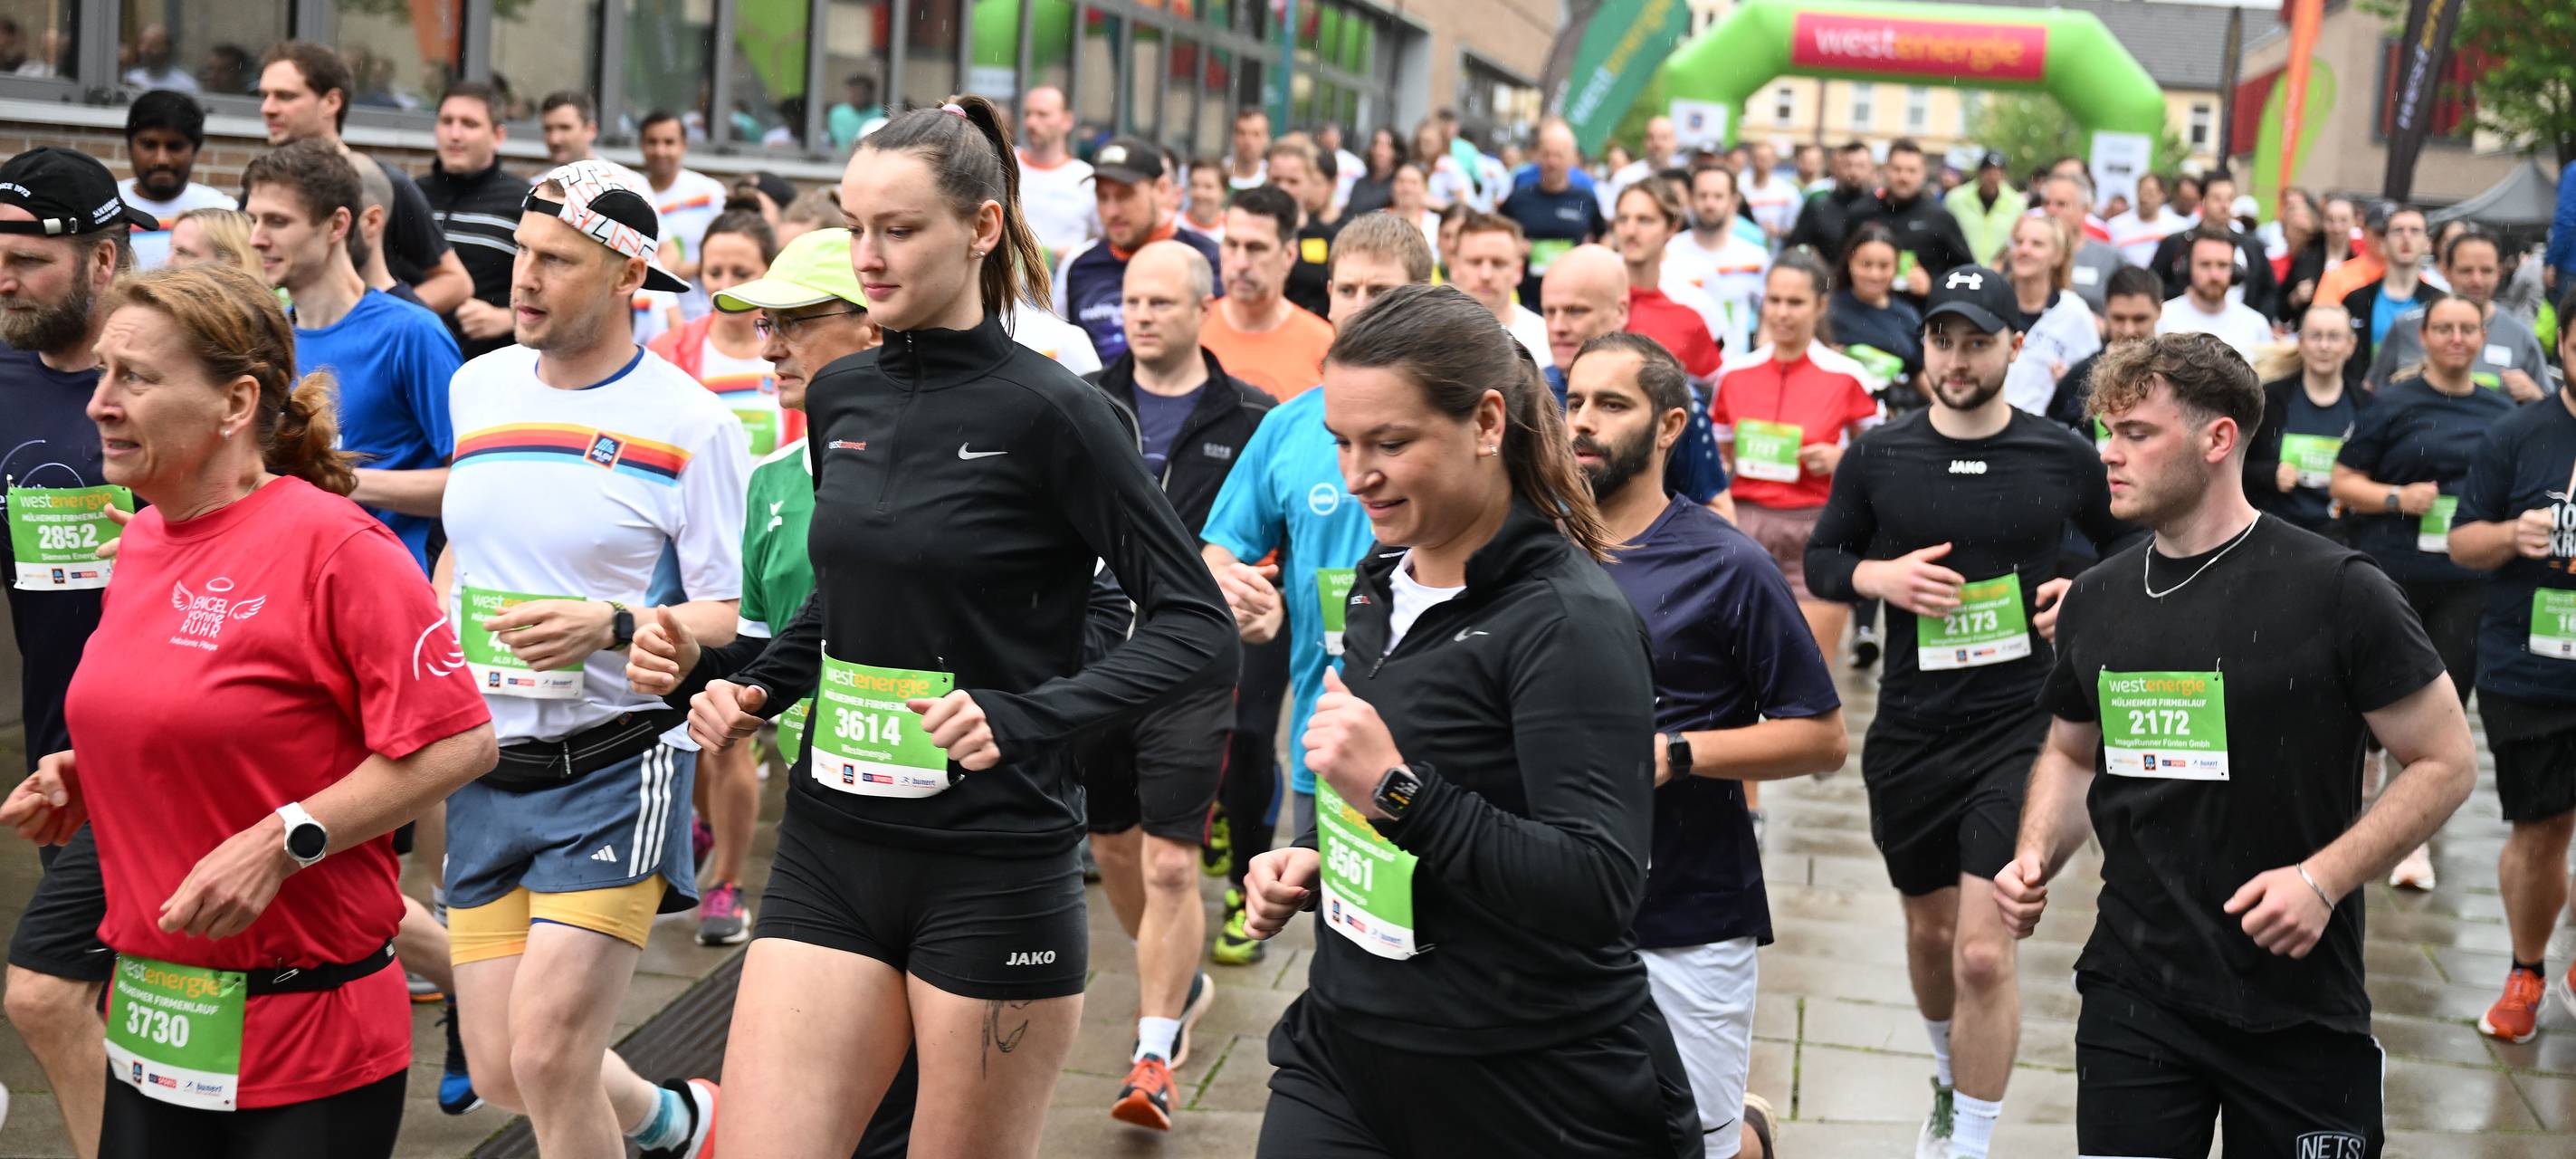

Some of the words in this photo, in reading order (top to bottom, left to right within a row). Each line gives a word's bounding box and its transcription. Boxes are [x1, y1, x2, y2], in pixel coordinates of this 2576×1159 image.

[1815, 24, 2025, 72] westenergie
[1949, 460, 1988, 474] JAKO
[20, 491, 112, 511] westenergie
[38, 523, 99, 550] 2852
[191, 596, 228, 614] ENGEL
[180, 619, 221, 638] RUHR
[1944, 608, 1999, 636] 2173
[825, 666, 930, 699] westenergie
[2109, 677, 2206, 696] westenergie
[2111, 697, 2157, 707] MÜLHEIMER
[2158, 698, 2207, 707] FIRMENLAUF
[835, 706, 902, 746] 3614
[2128, 709, 2190, 735] 2172
[2114, 738, 2161, 748] ImageRunner
[2162, 738, 2188, 747] Fünten
[2189, 739, 2210, 748] Gmbh
[1328, 836, 1374, 892] 3561
[1006, 950, 1056, 966] JAKO
[154, 994, 220, 1015] FIRMENLAUF
[126, 1001, 190, 1049] 3730
[2301, 1135, 2361, 1159] NETS
